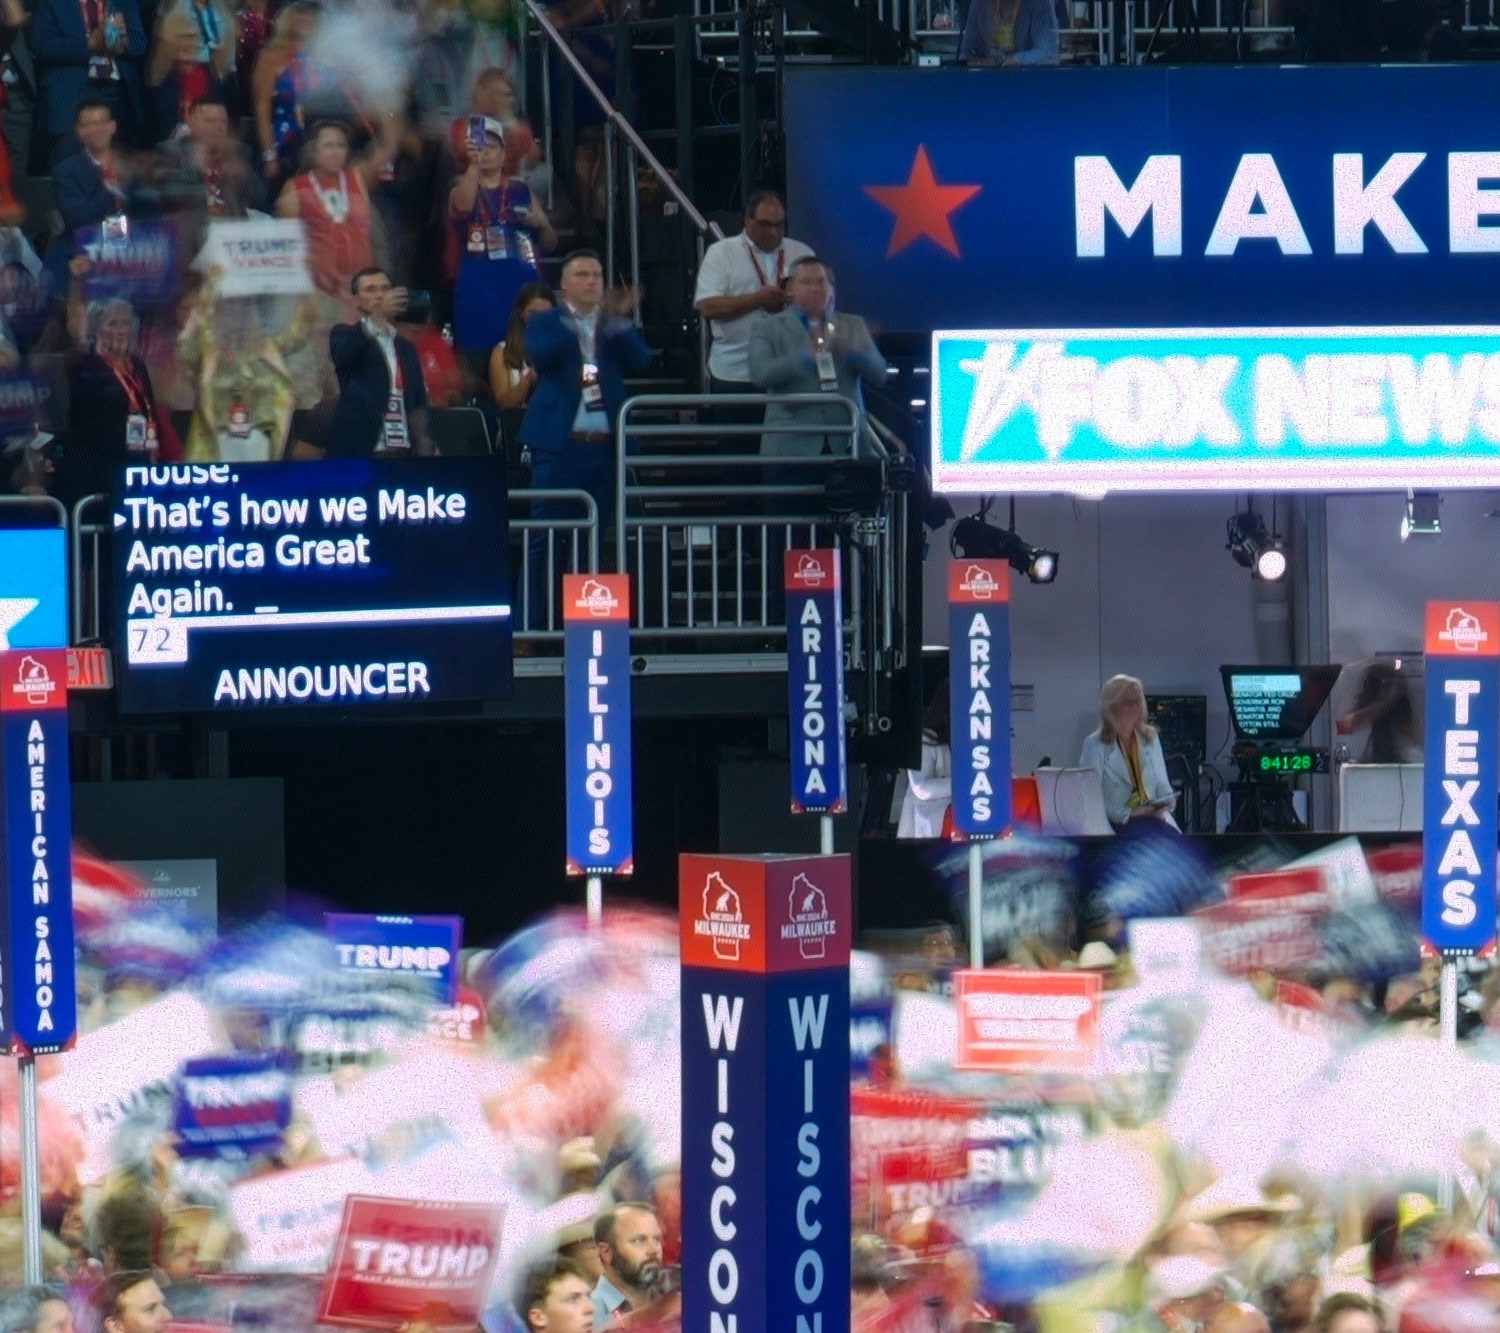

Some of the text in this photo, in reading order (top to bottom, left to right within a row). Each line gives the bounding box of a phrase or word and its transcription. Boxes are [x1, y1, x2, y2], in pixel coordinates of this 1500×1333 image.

[222, 238, 302, 257] TRUMP
[1040, 352, 1243, 450] FOX
[125, 487, 467, 529] That's how we Make
[127, 533, 370, 572] America Great
[128, 580, 234, 619] Again.
[132, 628, 172, 652] 72
[65, 650, 106, 686] EXIT
[214, 661, 431, 701] ANNOUNCER
[800, 598, 827, 794] ARIZONA
[968, 612, 993, 822] ARKANSAS
[587, 630, 611, 854] ILLINOIS
[1438, 680, 1481, 926] TEXAS
[27, 719, 53, 1031] AMERICAN SAMOA
[695, 919, 751, 940] MILWAUKEE
[781, 919, 836, 939] MILWAUKEE
[336, 945, 451, 971] TRUMP
[969, 1146, 1062, 1182] BLU
[349, 1237, 491, 1276] TRUMP
